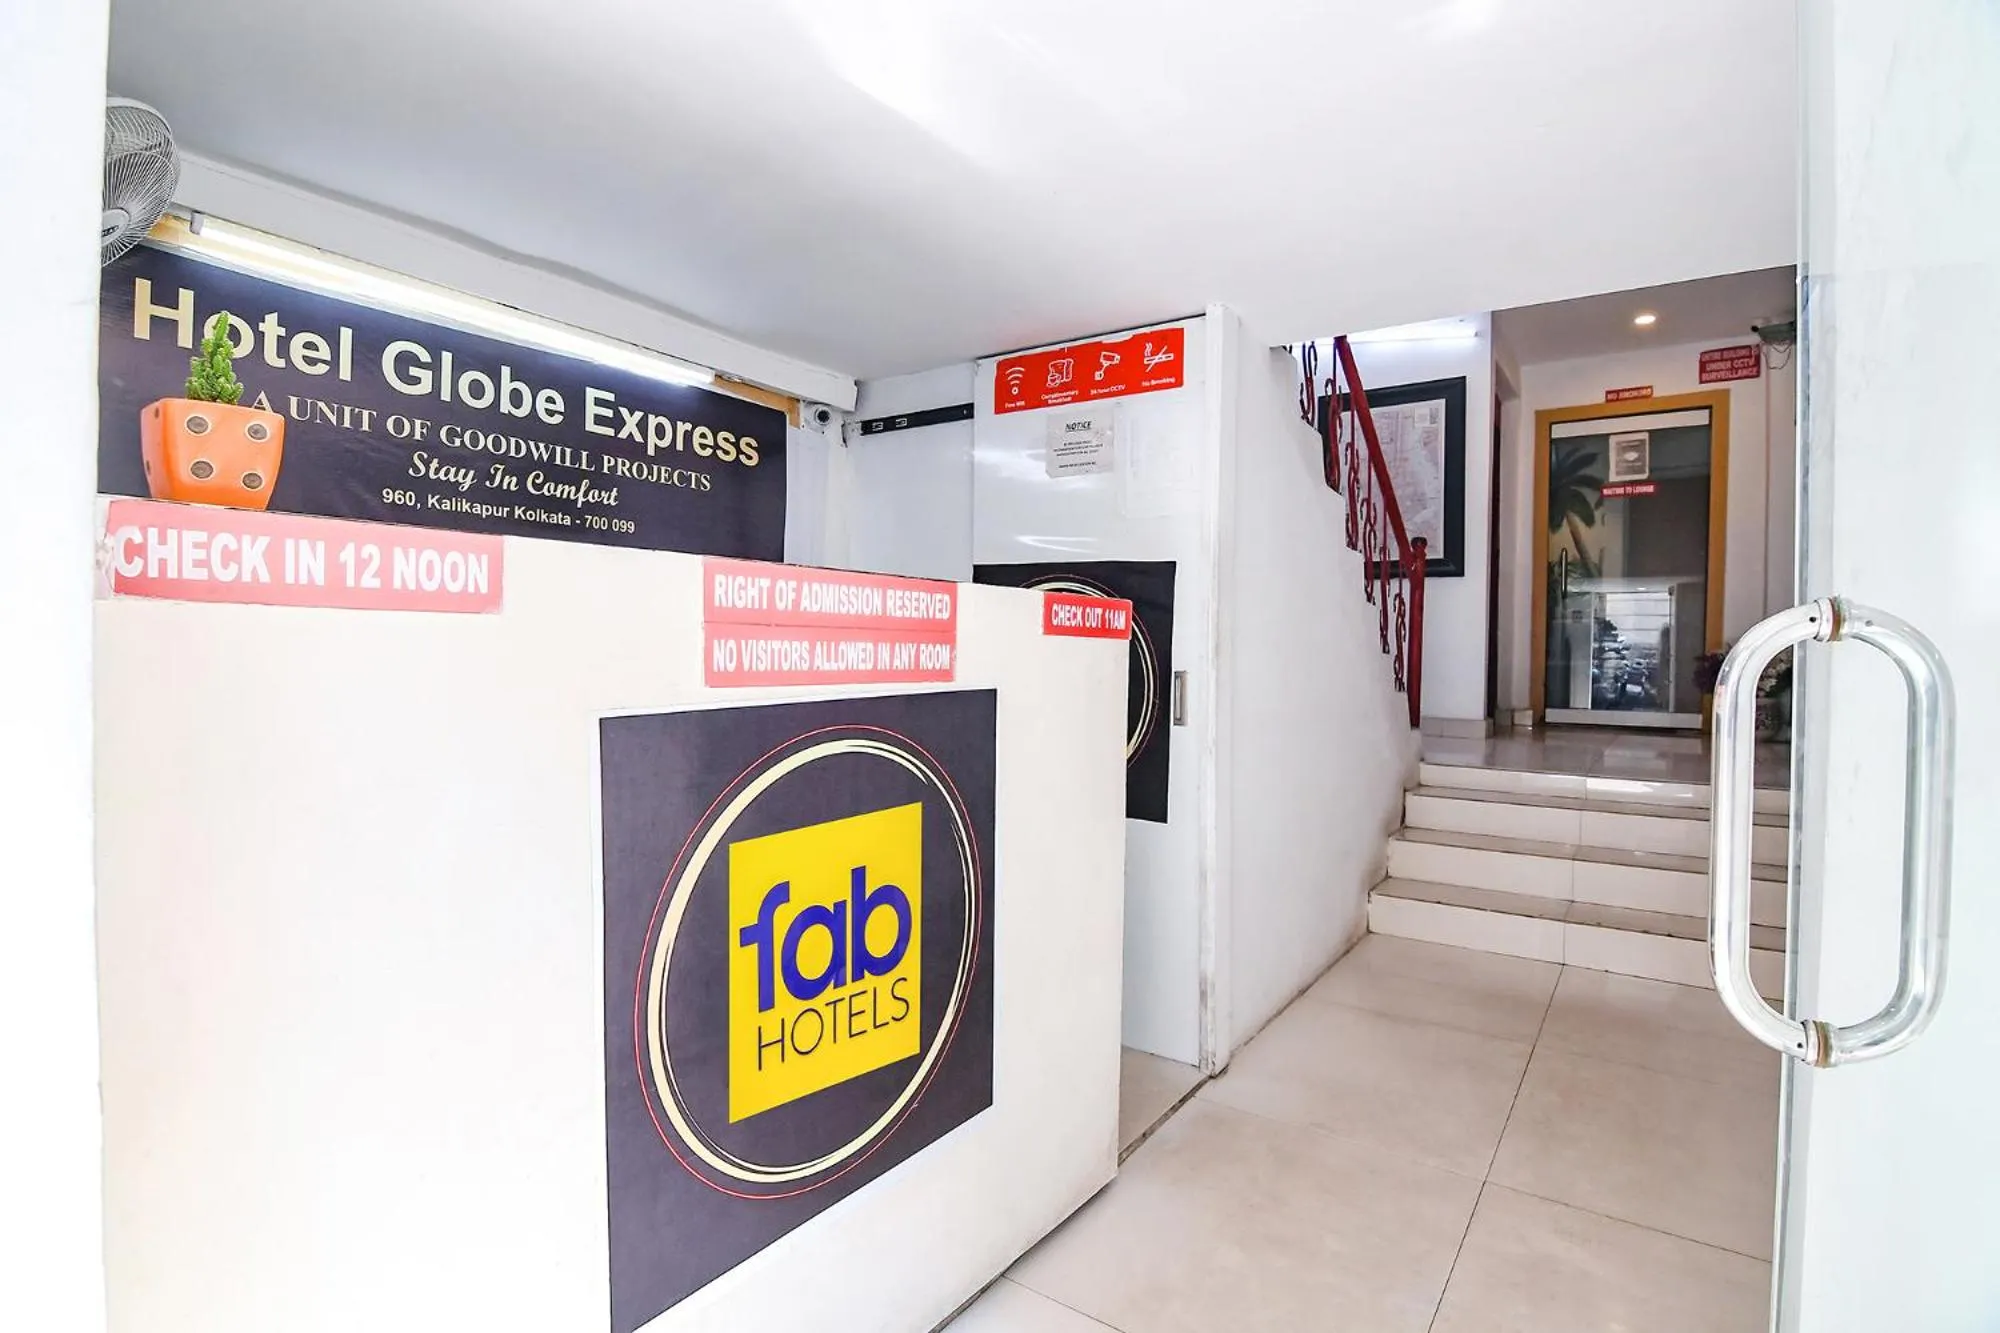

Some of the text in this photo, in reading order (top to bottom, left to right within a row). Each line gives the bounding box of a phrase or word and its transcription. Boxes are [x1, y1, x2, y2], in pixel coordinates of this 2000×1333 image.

[133, 277, 761, 467] Hotel Globe Express
[1702, 367, 1758, 381] SURVEILLANCE
[1732, 357, 1755, 368] CCTV
[251, 391, 712, 492] A UNIT OF GOODWILL PROJECTS
[1065, 420, 1092, 431] NOTICE
[408, 451, 619, 509] Stay In Comfort
[382, 488, 421, 510] 960,
[427, 493, 510, 523] Kalikapur
[514, 505, 571, 527] Kolkata
[584, 515, 608, 531] 700
[612, 518, 635, 535] 099
[115, 526, 489, 595] CHECK IN 12 NOON
[714, 574, 951, 621] RIGHT OF ADMISSION RESERVED
[1051, 602, 1126, 631] CHECK OUT 11AM
[713, 639, 951, 673] NO VISITORS ALLOWED IN ANY ROOM
[739, 865, 913, 1014] fab
[757, 976, 911, 1072] HOTELS
